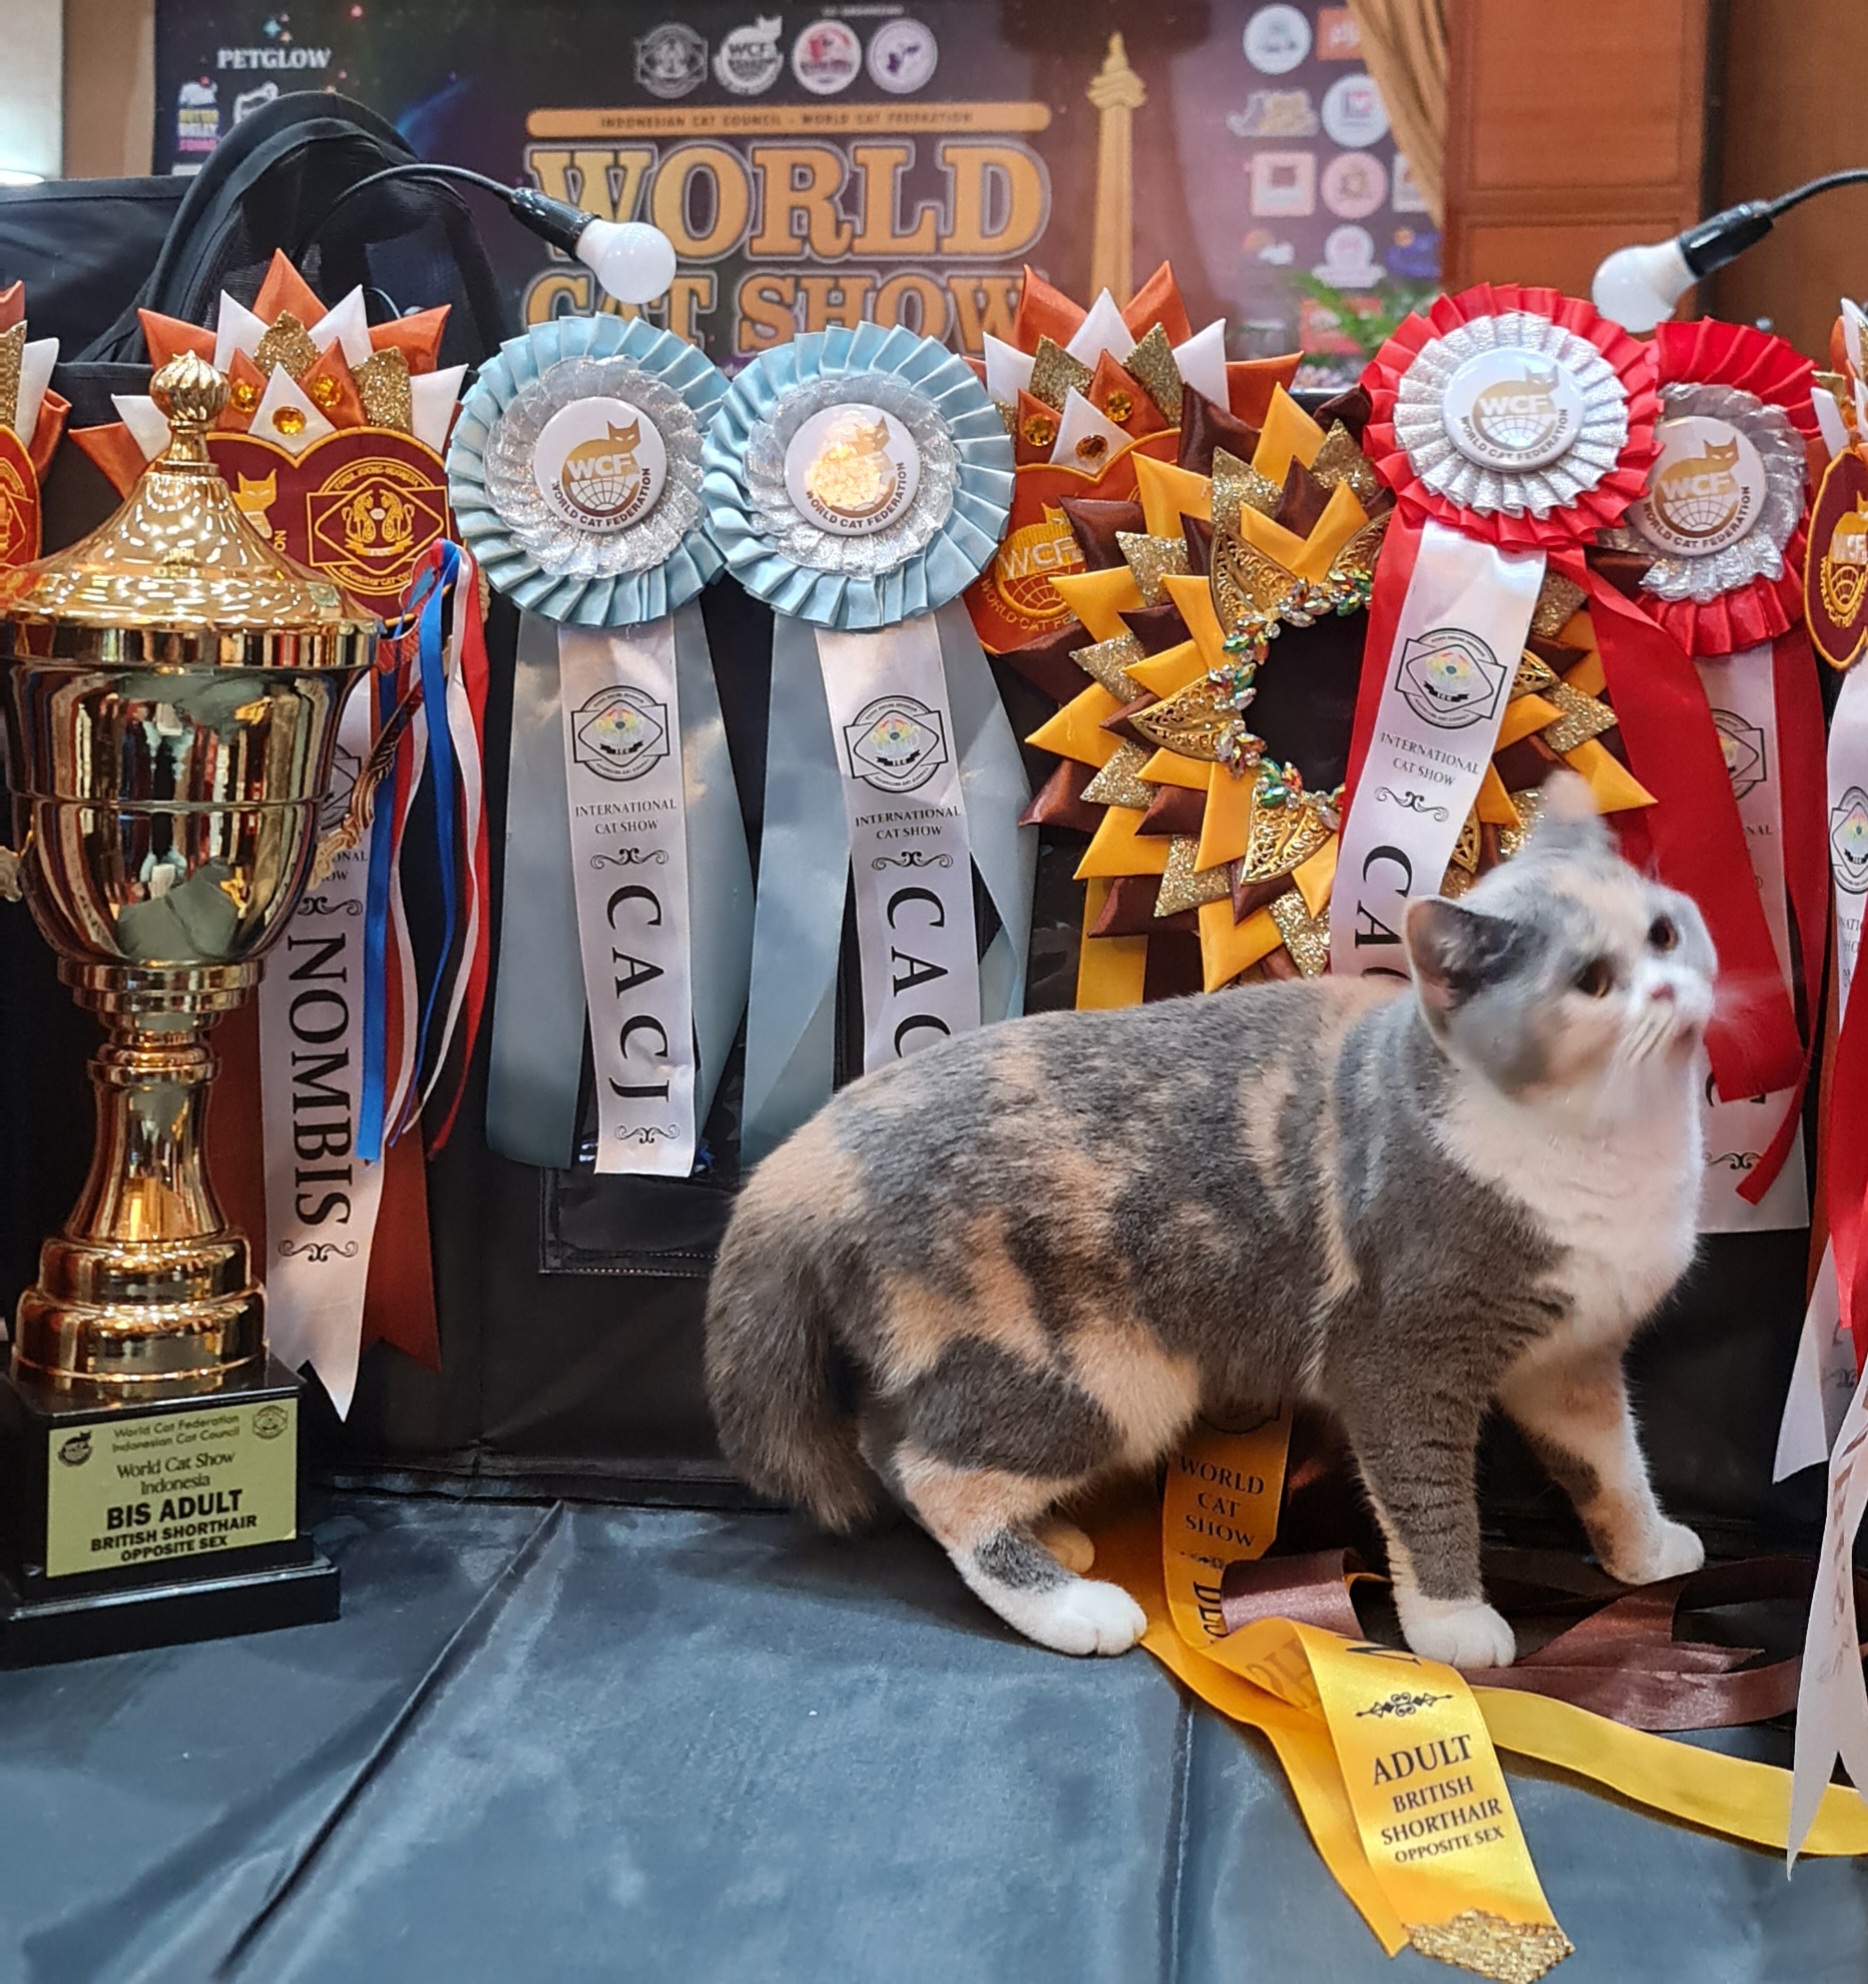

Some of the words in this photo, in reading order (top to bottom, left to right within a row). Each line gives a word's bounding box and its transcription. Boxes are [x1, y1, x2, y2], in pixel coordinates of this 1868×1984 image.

[217, 47, 331, 69] PETGLOW
[601, 116, 686, 128] INDONESIAN
[722, 114, 782, 127] COUNCIL
[525, 140, 1050, 261] WORLD
[734, 269, 1040, 357] SHOW
[1478, 394, 1549, 416] WCF
[1460, 415, 1488, 451] WORLD
[1488, 448, 1513, 460] CAT
[1516, 408, 1568, 461] FEDERATION
[566, 453, 632, 481] WCF
[551, 480, 579, 519] WORLD
[580, 515, 602, 527] CAT
[606, 467, 651, 527] FEDERATION
[806, 489, 838, 524] WORLD
[840, 519, 864, 529] CAT
[867, 461, 907, 526] FEDERATION
[1658, 472, 1731, 500] WCF
[1643, 502, 1673, 541] WORLD
[1673, 537, 1699, 548] CAT
[1702, 486, 1750, 548] FEDERATION
[998, 536, 1074, 580] WCF
[981, 577, 1017, 624] WORLD
[1019, 616, 1047, 632] CAT
[1380, 732, 1480, 775] INTERNATIONAL
[1393, 758, 1415, 773] CAT
[1419, 765, 1455, 786] SHOW
[575, 799, 676, 817] INTERNATIONAL
[855, 806, 961, 828] INTERNATIONAL
[595, 822, 618, 835] CAT
[621, 820, 659, 833] SHOW
[876, 829, 899, 840] CAT
[903, 826, 943, 838] SHOW
[1355, 845, 1412, 981] CA
[606, 885, 670, 1102] CACJ
[287, 932, 353, 1227] NOMBIS
[112, 1438, 173, 1453] Indonesian
[176, 1432, 198, 1445] Cat
[200, 1427, 240, 1440] Council
[114, 1426, 150, 1439] World
[154, 1421, 174, 1434] Cat
[179, 1415, 239, 1431] Federation
[117, 1460, 161, 1479] World
[164, 1456, 192, 1472] Cat
[197, 1452, 235, 1468] Show
[1180, 1455, 1264, 1496] WORLD
[140, 1474, 210, 1496] Indonesia
[107, 1502, 151, 1531] BIS
[159, 1489, 243, 1523] ADULT
[1197, 1492, 1241, 1518] CAT
[91, 1529, 157, 1552] BRITISH
[162, 1515, 257, 1540] SHORTHAIR
[121, 1541, 194, 1561] OPPOSITE
[199, 1536, 228, 1550] SEX
[1185, 1514, 1256, 1548] SHOW
[1372, 1734, 1474, 1786] ADULT
[1391, 1775, 1474, 1813] BRITISH
[1380, 1798, 1504, 1846] SHORTHAIR
[1394, 1835, 1474, 1864] OPPOSITE
[1475, 1825, 1506, 1845] SEX
